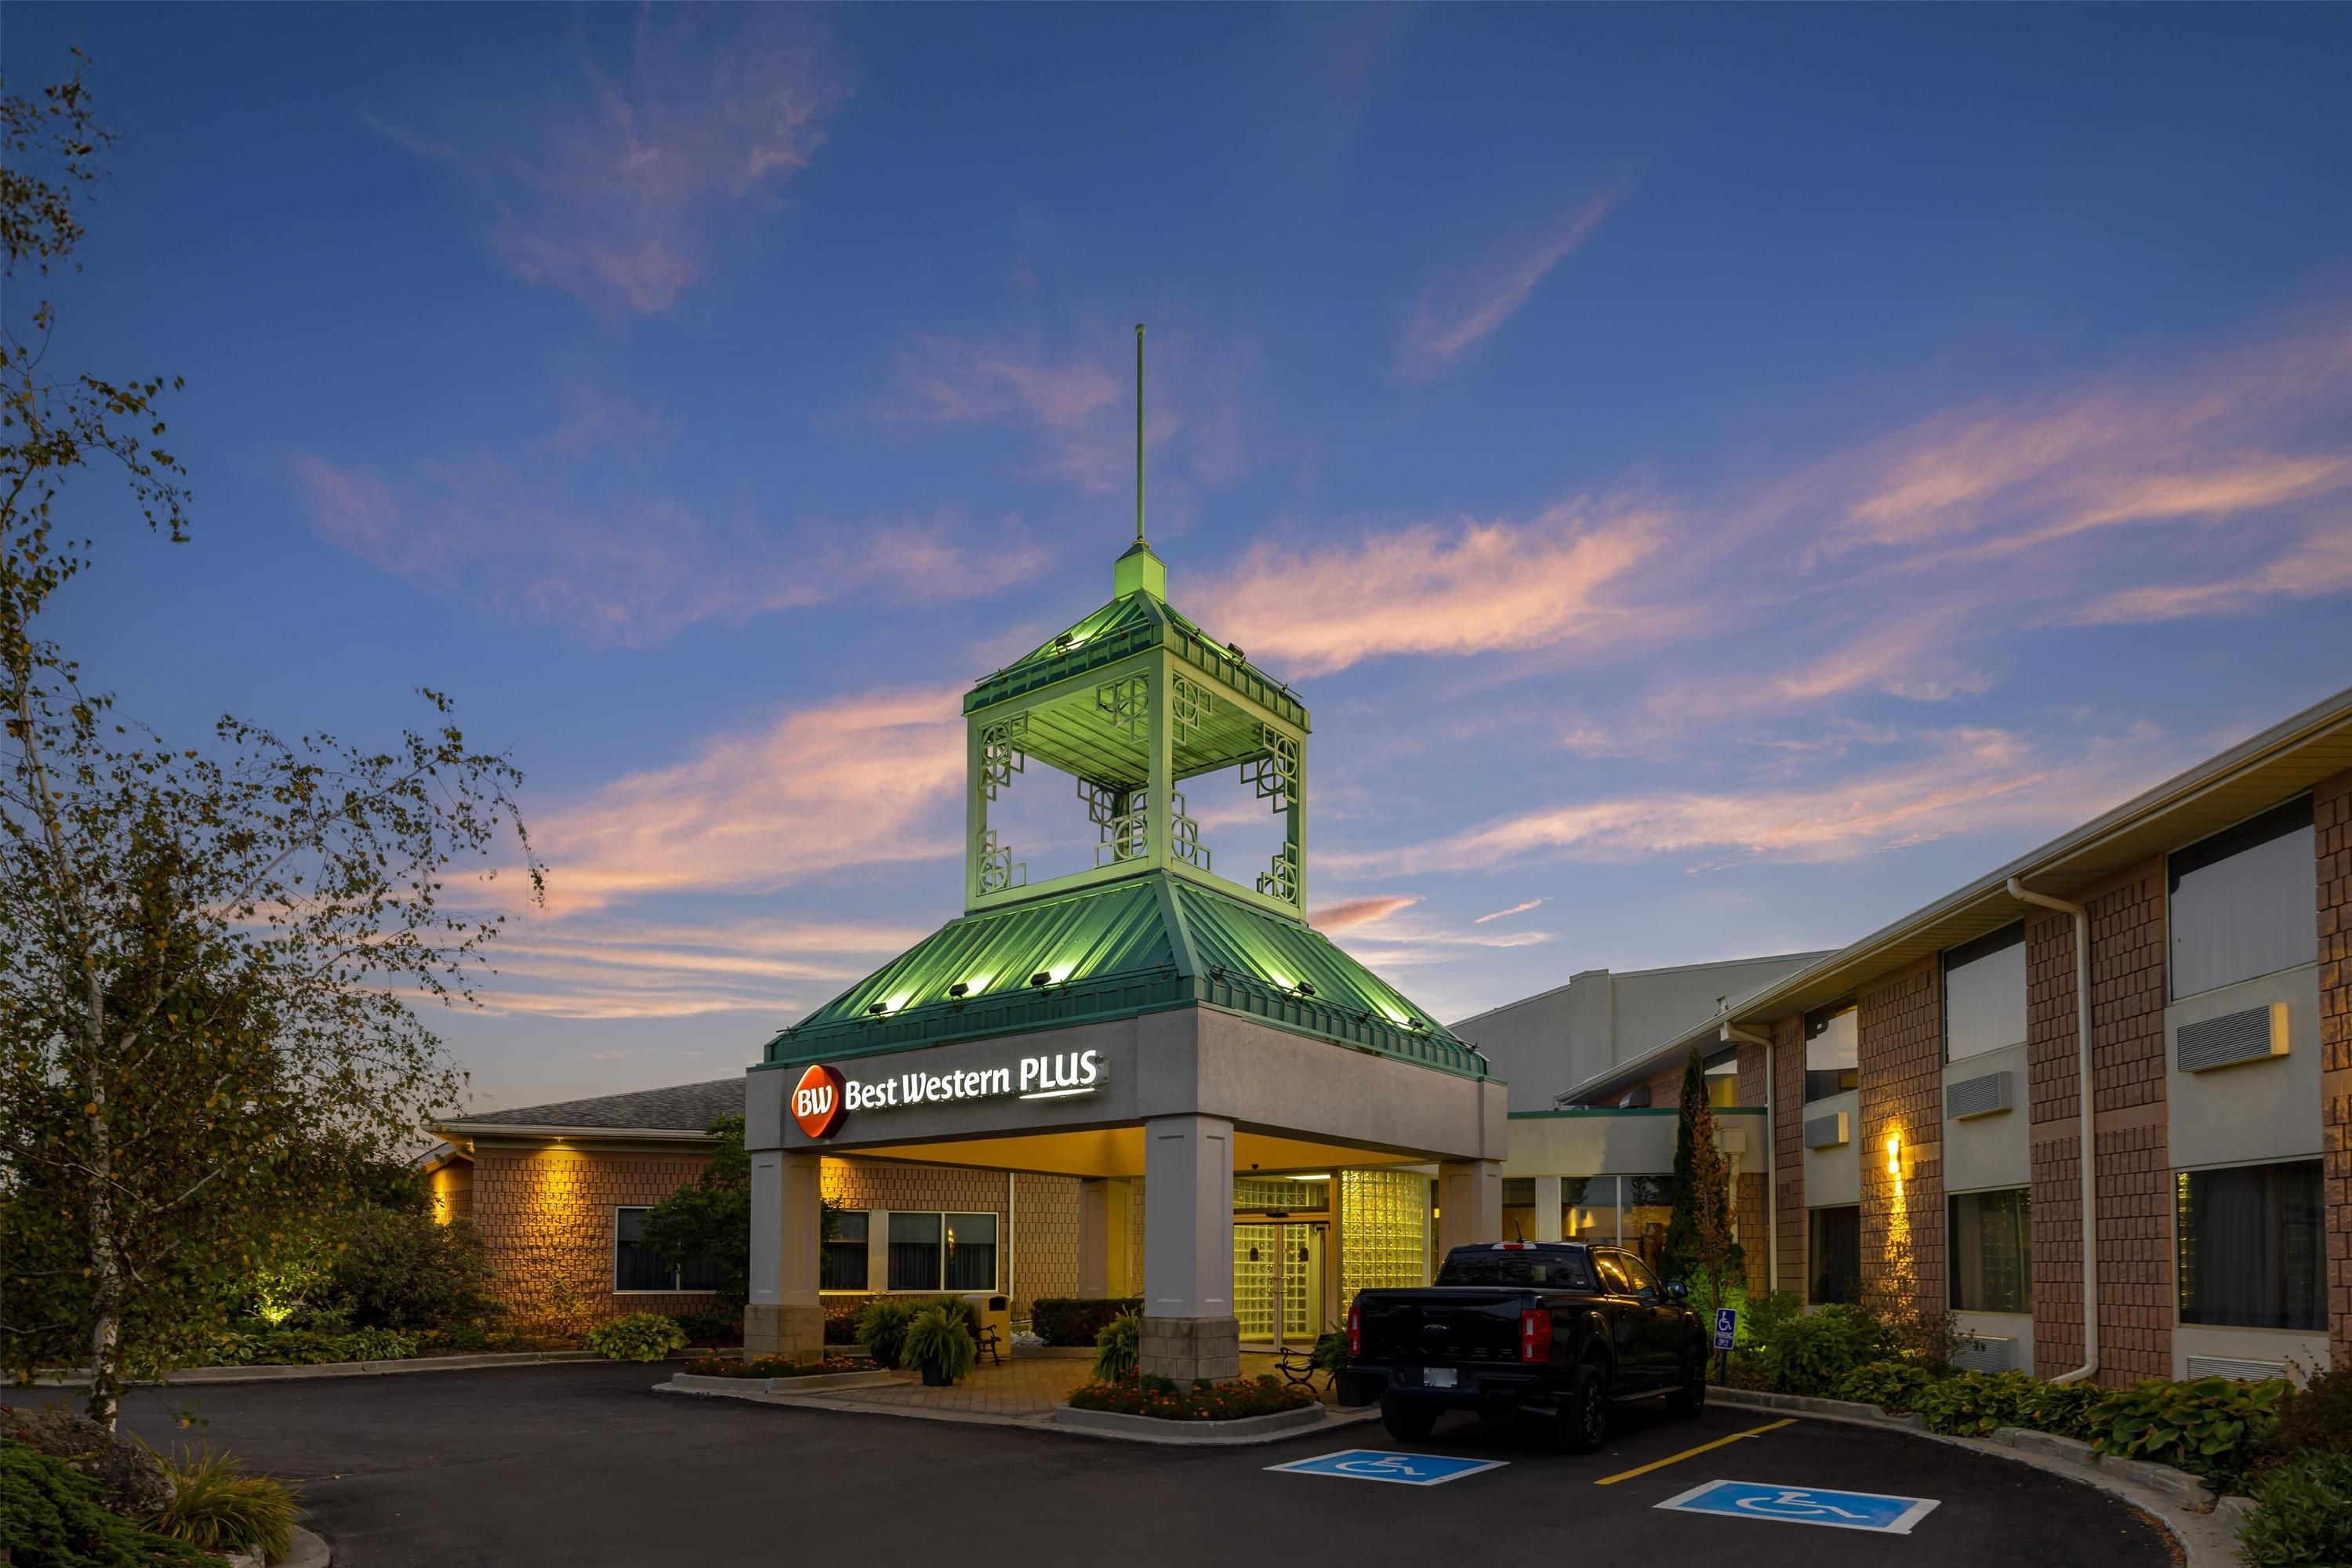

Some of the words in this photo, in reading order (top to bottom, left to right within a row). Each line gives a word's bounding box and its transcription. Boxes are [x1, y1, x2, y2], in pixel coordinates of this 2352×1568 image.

[797, 1085, 833, 1117] BW
[845, 1079, 898, 1110] Best
[902, 1067, 1011, 1105] Western
[1020, 1050, 1097, 1090] PLUS
